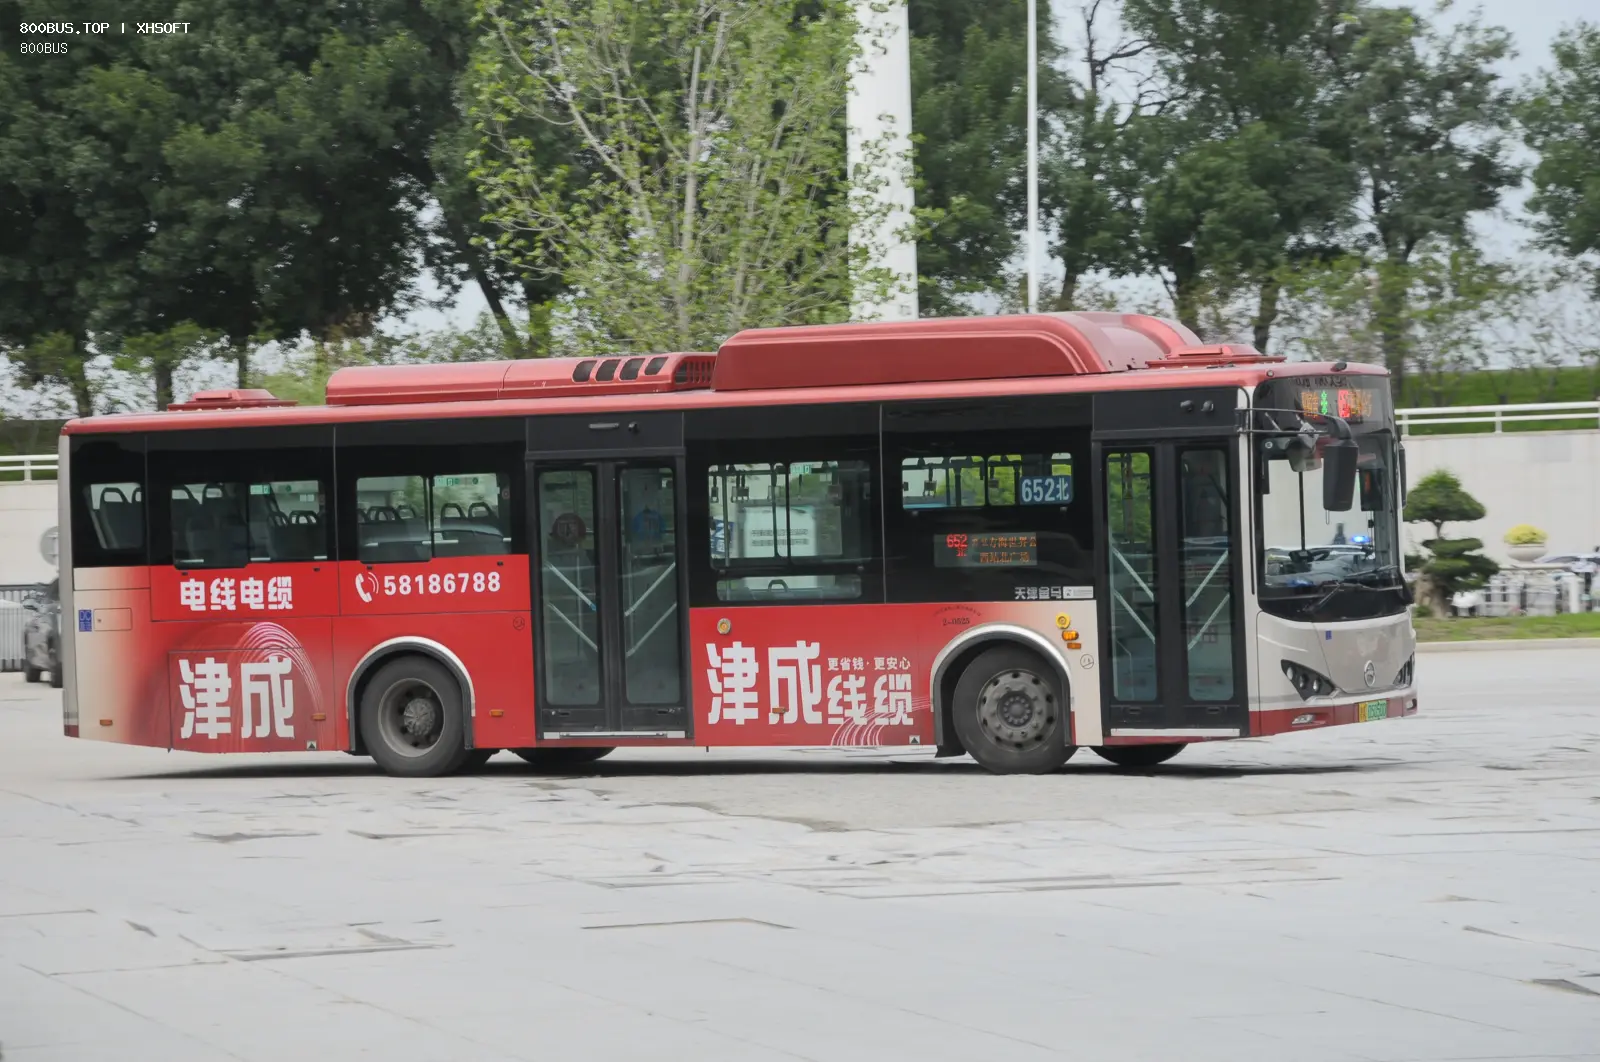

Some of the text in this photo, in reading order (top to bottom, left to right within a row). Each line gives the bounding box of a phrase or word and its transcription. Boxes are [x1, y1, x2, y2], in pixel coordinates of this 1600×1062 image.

[1021, 478, 1070, 502] 652北
[946, 533, 968, 547] 652
[180, 576, 293, 611] 电线电缆
[383, 571, 502, 596] 58186788
[827, 656, 911, 672] 更省钱·更安心
[705, 640, 823, 725] 津成
[178, 656, 295, 740] 津成
[826, 674, 914, 726] 线缆
